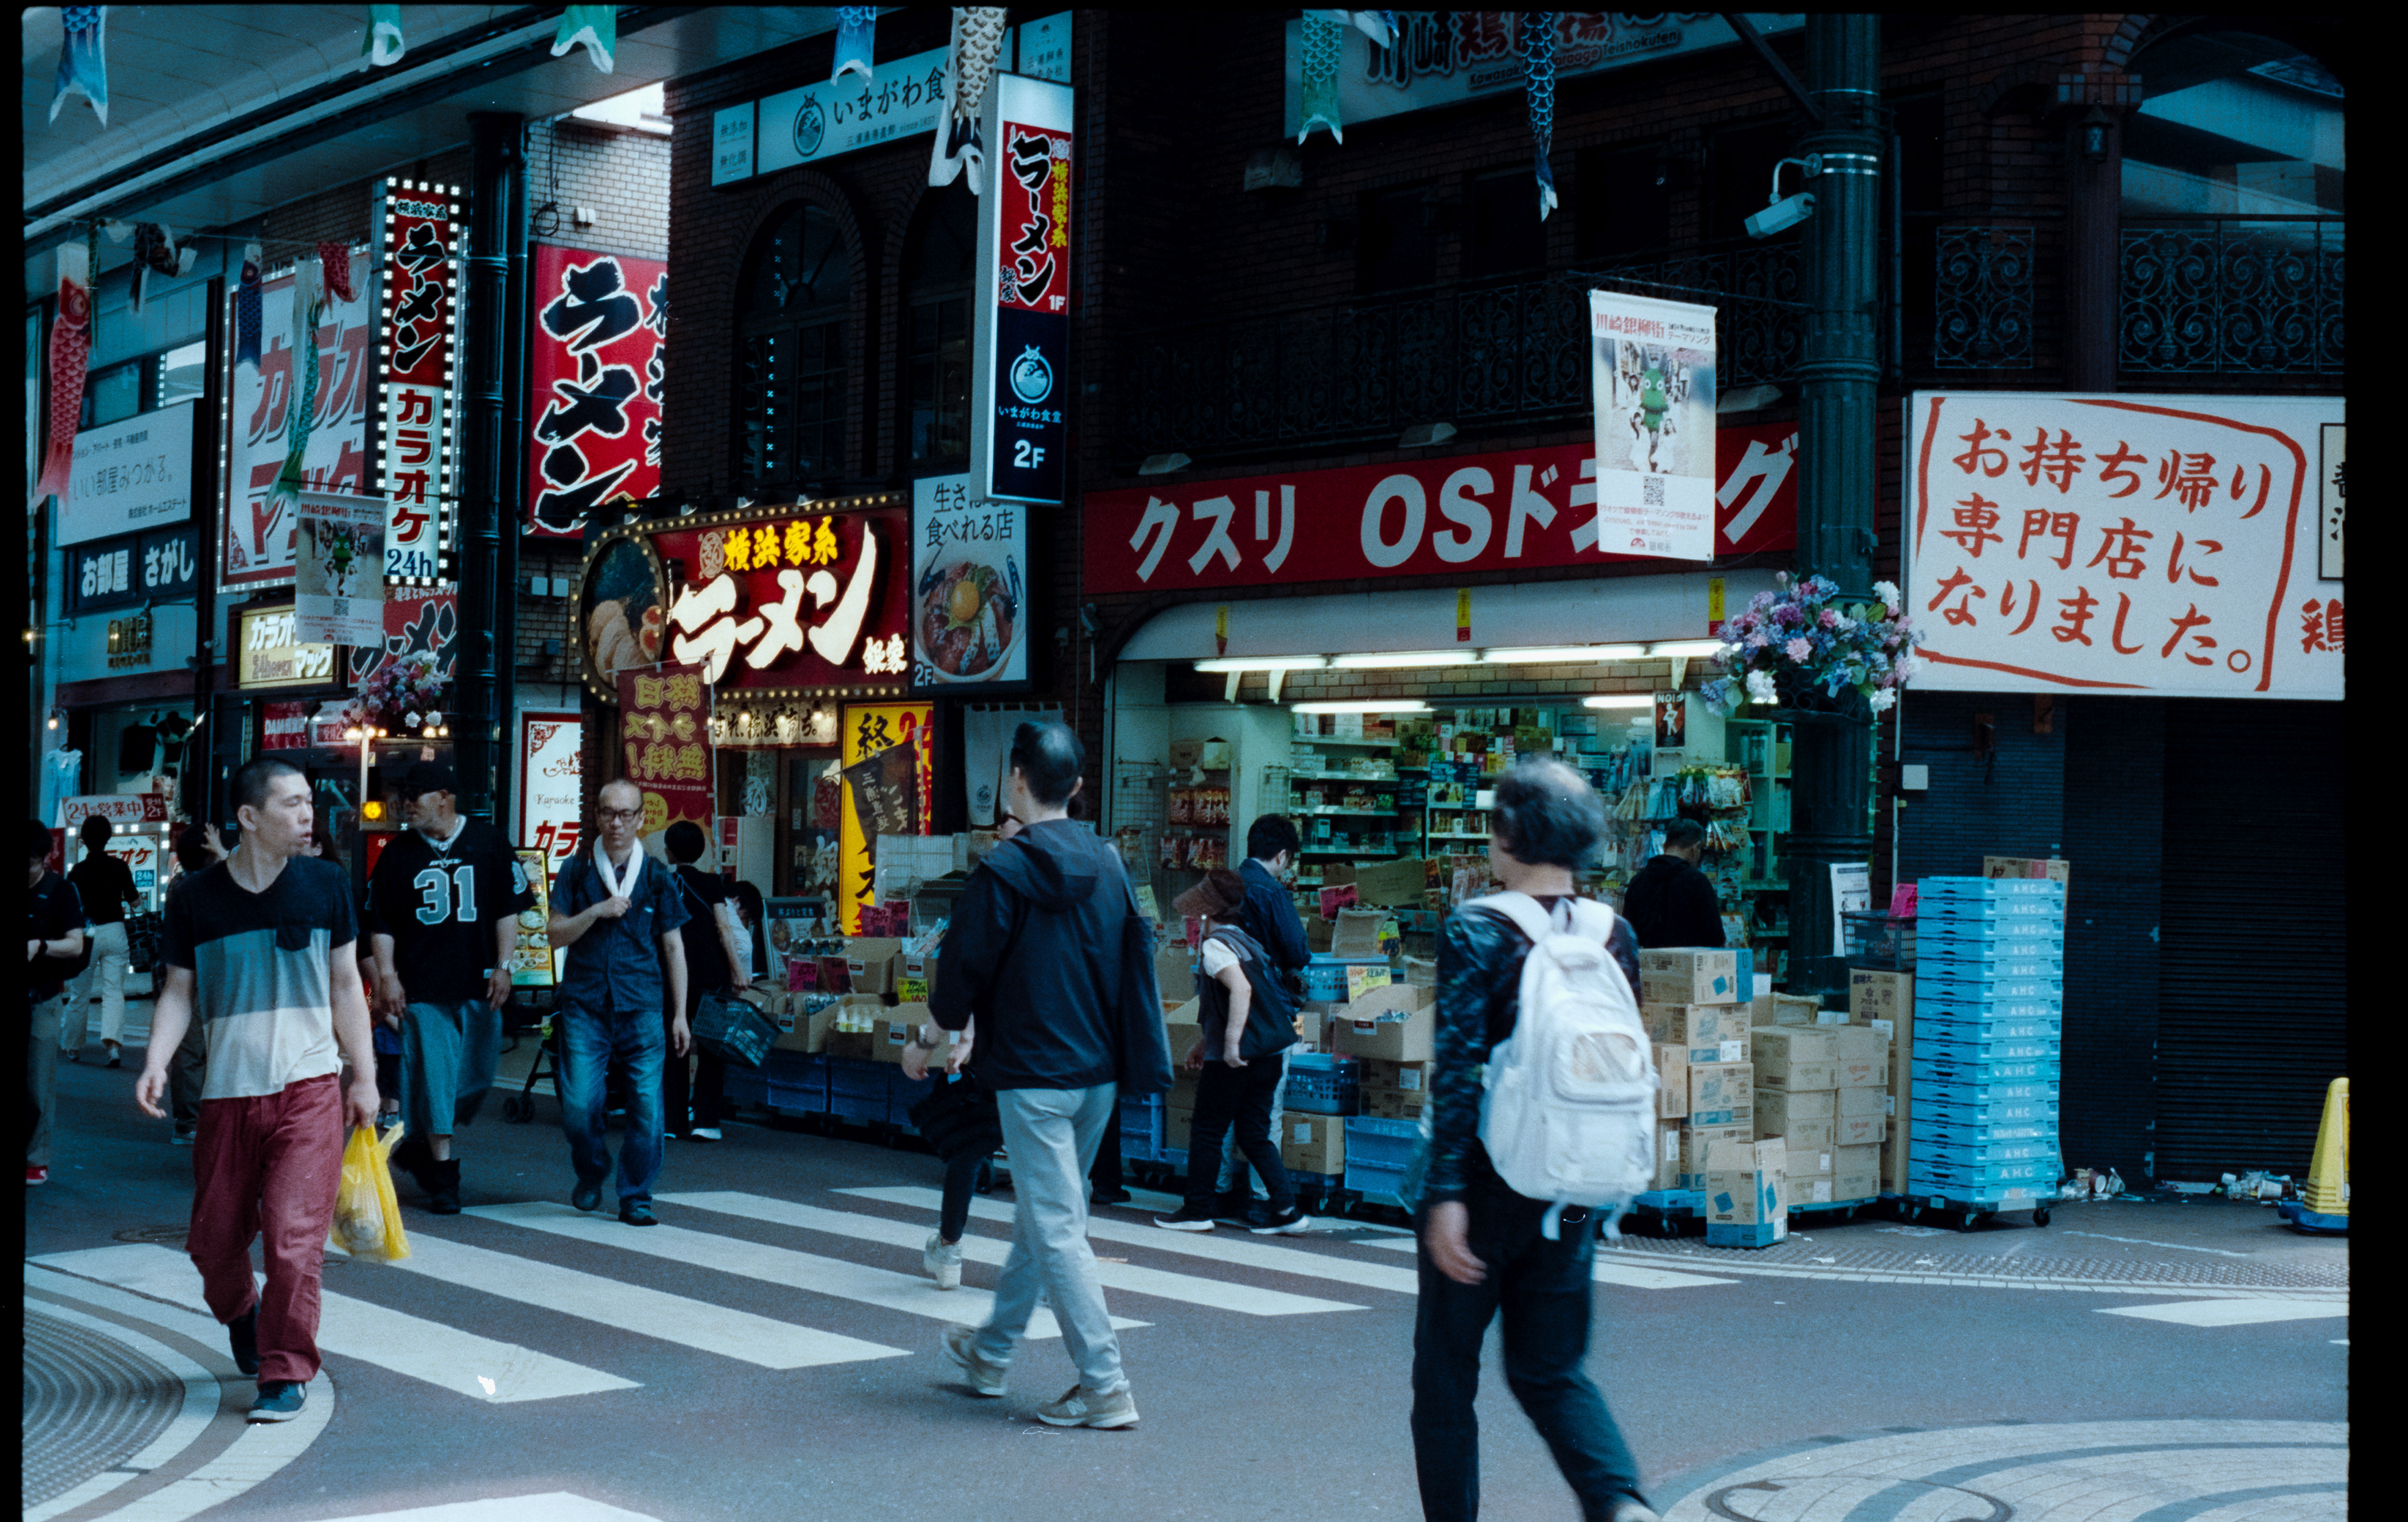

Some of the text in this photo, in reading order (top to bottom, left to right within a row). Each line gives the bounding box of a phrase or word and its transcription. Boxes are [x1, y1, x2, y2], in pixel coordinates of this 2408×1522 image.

[1601, 31, 1677, 56] Teishokuten
[1006, 124, 1055, 306] ラーメン
[393, 221, 446, 374] ラーメン
[1048, 295, 1065, 310] 1F
[534, 256, 643, 533] ラーメン
[998, 406, 1062, 423] いまがわ食堂
[1014, 439, 1045, 469] 2F
[391, 388, 435, 544] カラオケ
[1951, 418, 2273, 520] お持ち帰り
[925, 509, 1014, 547] 食べれる店
[1129, 485, 1296, 583] クスリ
[723, 515, 839, 571] 横浜家系
[1939, 492, 2224, 588] 専門店に
[82, 537, 194, 597] お部屋 さがし
[387, 549, 433, 576] 24h
[668, 519, 878, 685] ラーメン
[1928, 566, 2252, 673] なりました。
[2300, 598, 2345, 654] 鶏
[294, 647, 333, 679] マック
[914, 663, 934, 687] 2F
[534, 793, 576, 808] Karaoke
[146, 805, 164, 818] 2F
[414, 865, 477, 926] 31
[2013, 884, 2037, 894] AHC
[2013, 904, 2037, 914] AHC
[2013, 924, 2037, 934] AHC
[2012, 944, 2036, 955] AHC
[2012, 965, 2036, 975] AHC
[2011, 985, 2034, 996] AHC
[2010, 1006, 2034, 1016] AHC
[2009, 1026, 2033, 1036] AHC
[2009, 1047, 2032, 1057] AHC
[2003, 1065, 2036, 1076] AHC
[2007, 1087, 2031, 1097] AHC
[2006, 1107, 2030, 1118] AHC
[2005, 1148, 2029, 1158] AHC
[2000, 1167, 2033, 1179] AHC
[2004, 1188, 2027, 1199] AC
